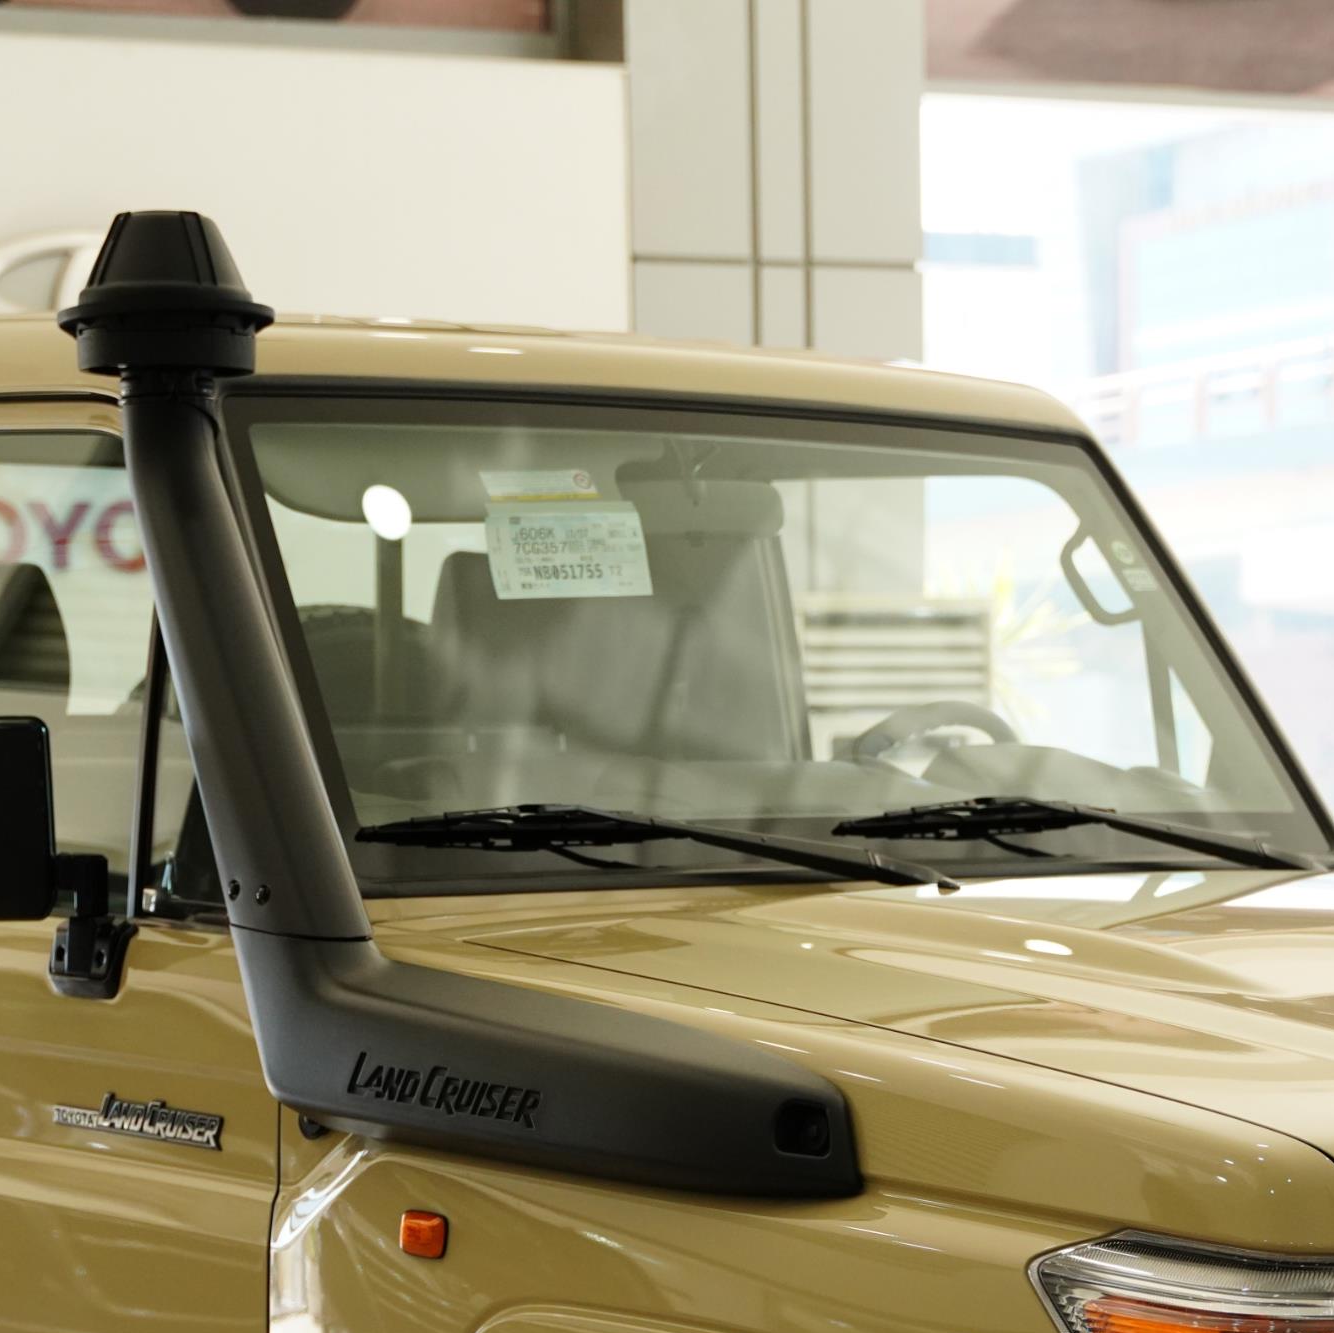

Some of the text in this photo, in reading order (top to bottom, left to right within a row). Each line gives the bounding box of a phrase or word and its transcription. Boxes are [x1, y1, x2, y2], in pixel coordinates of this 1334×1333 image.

[347, 1051, 541, 1129] LAND CRUISER
[54, 1107, 98, 1128] TOYOTA
